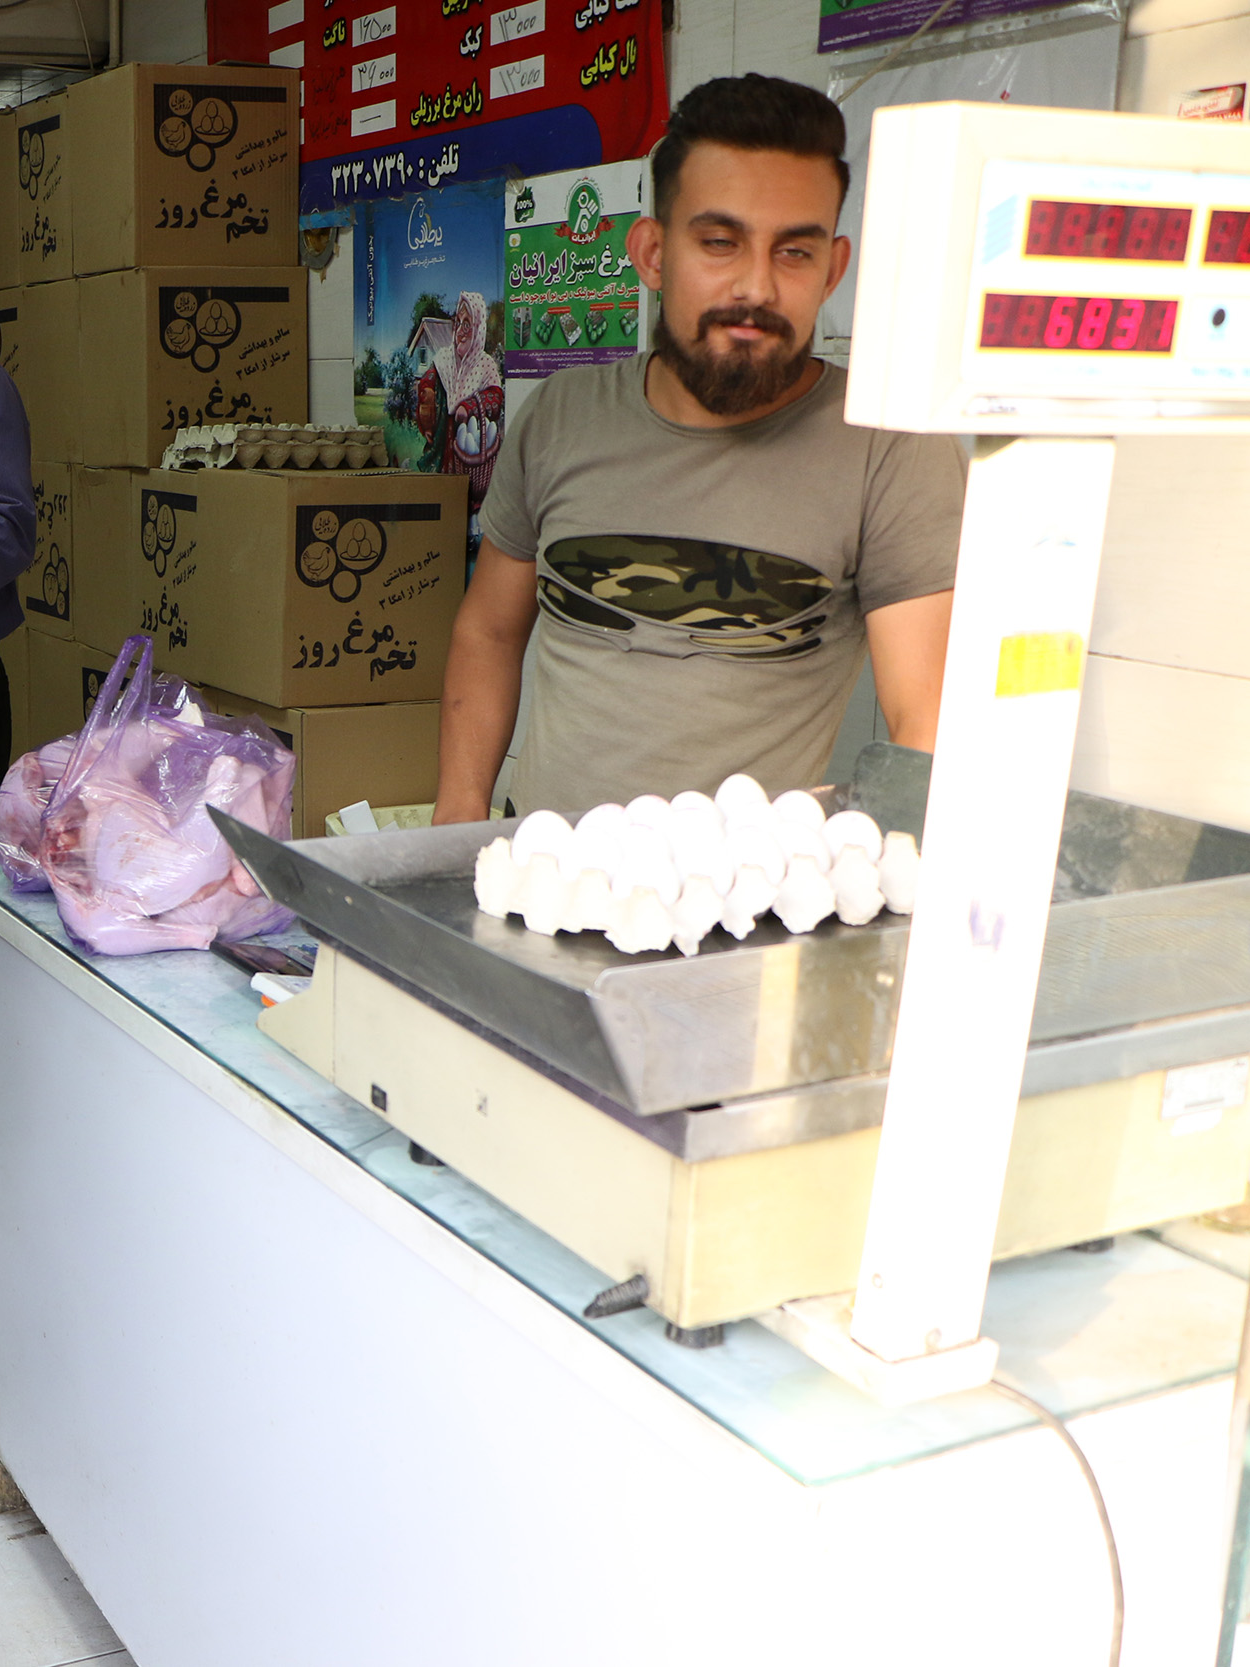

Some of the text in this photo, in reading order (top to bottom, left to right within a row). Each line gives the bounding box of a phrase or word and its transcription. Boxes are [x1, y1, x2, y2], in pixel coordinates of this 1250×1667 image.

[323, 19, 346, 47] ناگت
[460, 25, 483, 58] کبک
[580, 37, 637, 85] بال کبابی
[410, 80, 482, 126] ران مرغ برزیلی
[331, 152, 414, 197] ۳۲۳۰۷۳۹۰
[155, 179, 269, 243] تخم مرغ روز
[509, 249, 568, 287] ایرانیان
[566, 251, 596, 283] سبز
[161, 400, 203, 430] روز
[205, 379, 252, 418] مرغ
[382, 550, 440, 587] سالم و بهداشتی
[418, 576, 440, 596] سرشار
[378, 598, 386, 610] ۳
[407, 585, 415, 600] از
[140, 586, 188, 652] تخم مرغ روز
[292, 610, 417, 682] تخم مرغ روز
